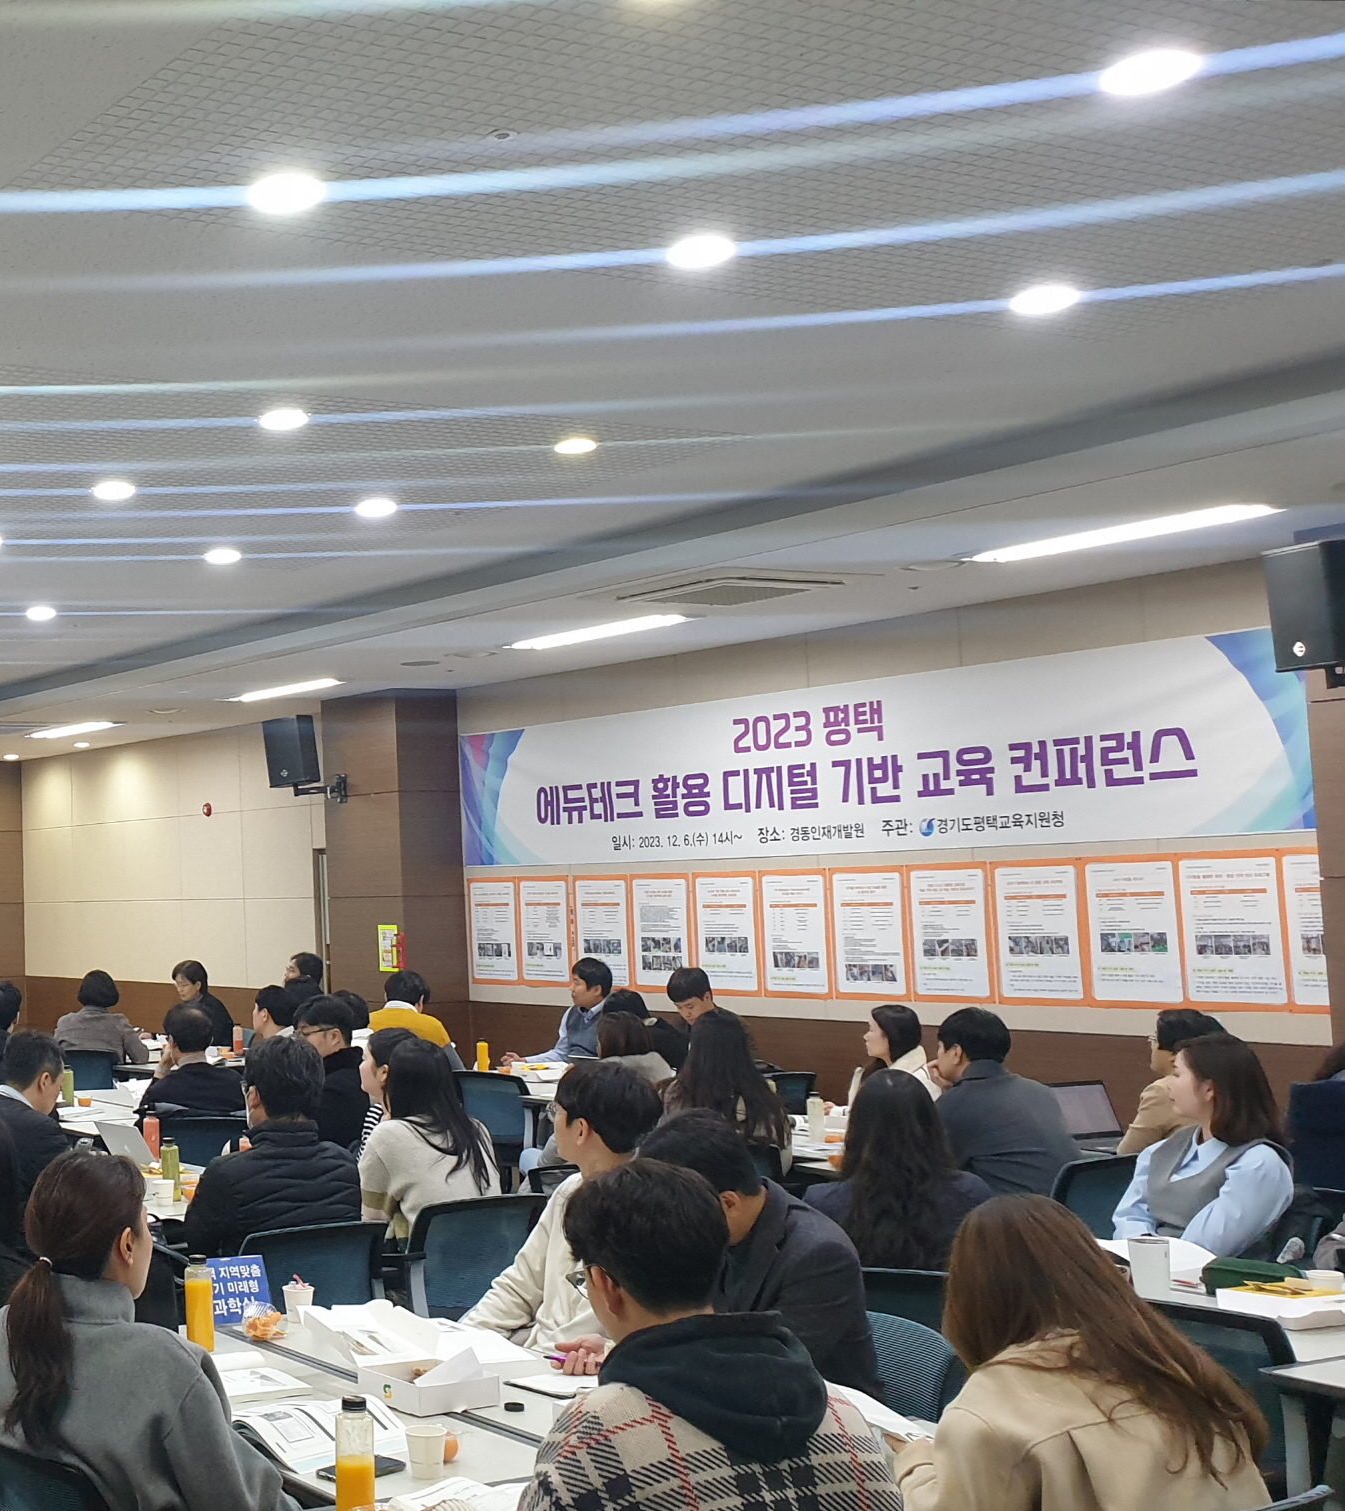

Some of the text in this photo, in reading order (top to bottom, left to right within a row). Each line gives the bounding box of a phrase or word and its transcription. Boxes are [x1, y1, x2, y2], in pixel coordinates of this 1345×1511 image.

[732, 700, 885, 755] 2023 평택
[536, 727, 1199, 826] 에듀테크 활용 디지털 기반 교육 컨퍼런스
[612, 835, 635, 851] 일시:
[639, 835, 664, 849] 2023.
[667, 834, 681, 848] 12.
[712, 829, 743, 846] 14시~
[757, 826, 785, 844] 장소:
[790, 822, 865, 843] 경동인재개발원
[881, 818, 913, 837] 주관:
[937, 810, 1065, 835] 경기도평택교육지원청
[218, 1264, 261, 1279] 지역맞춤
[227, 1279, 259, 1294] 미래형
